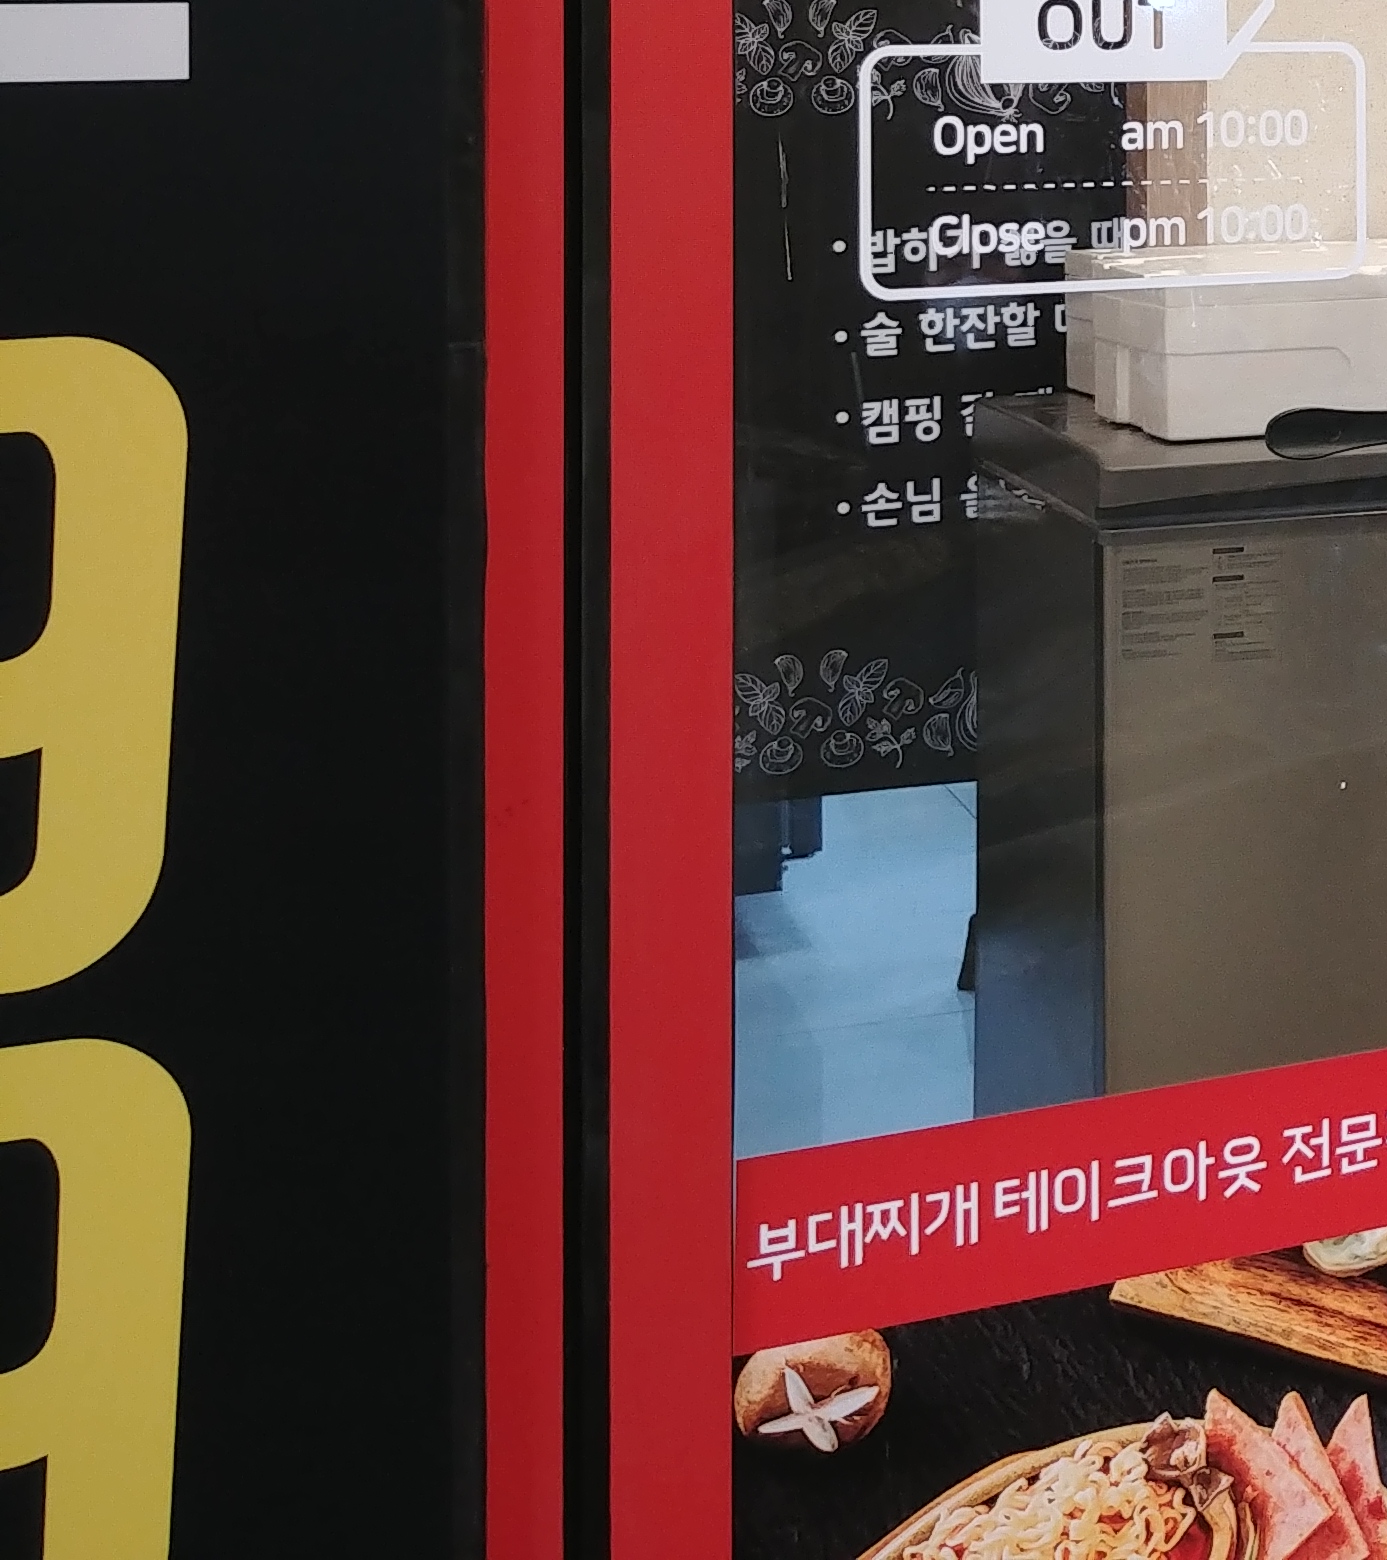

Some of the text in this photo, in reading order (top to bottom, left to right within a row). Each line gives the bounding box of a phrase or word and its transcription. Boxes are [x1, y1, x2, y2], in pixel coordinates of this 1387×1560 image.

[932, 109, 1309, 165] Open am 10:00
[1122, 212, 1187, 254] pm
[1197, 204, 1309, 246] 10:00
[860, 311, 903, 358] 술
[918, 301, 1041, 354] 한잔할
[861, 395, 942, 446] 캠핑
[860, 476, 942, 528] 손님
[746, 1180, 981, 1283] 부대찌개
[993, 1135, 1267, 1235] 테이크아웃
